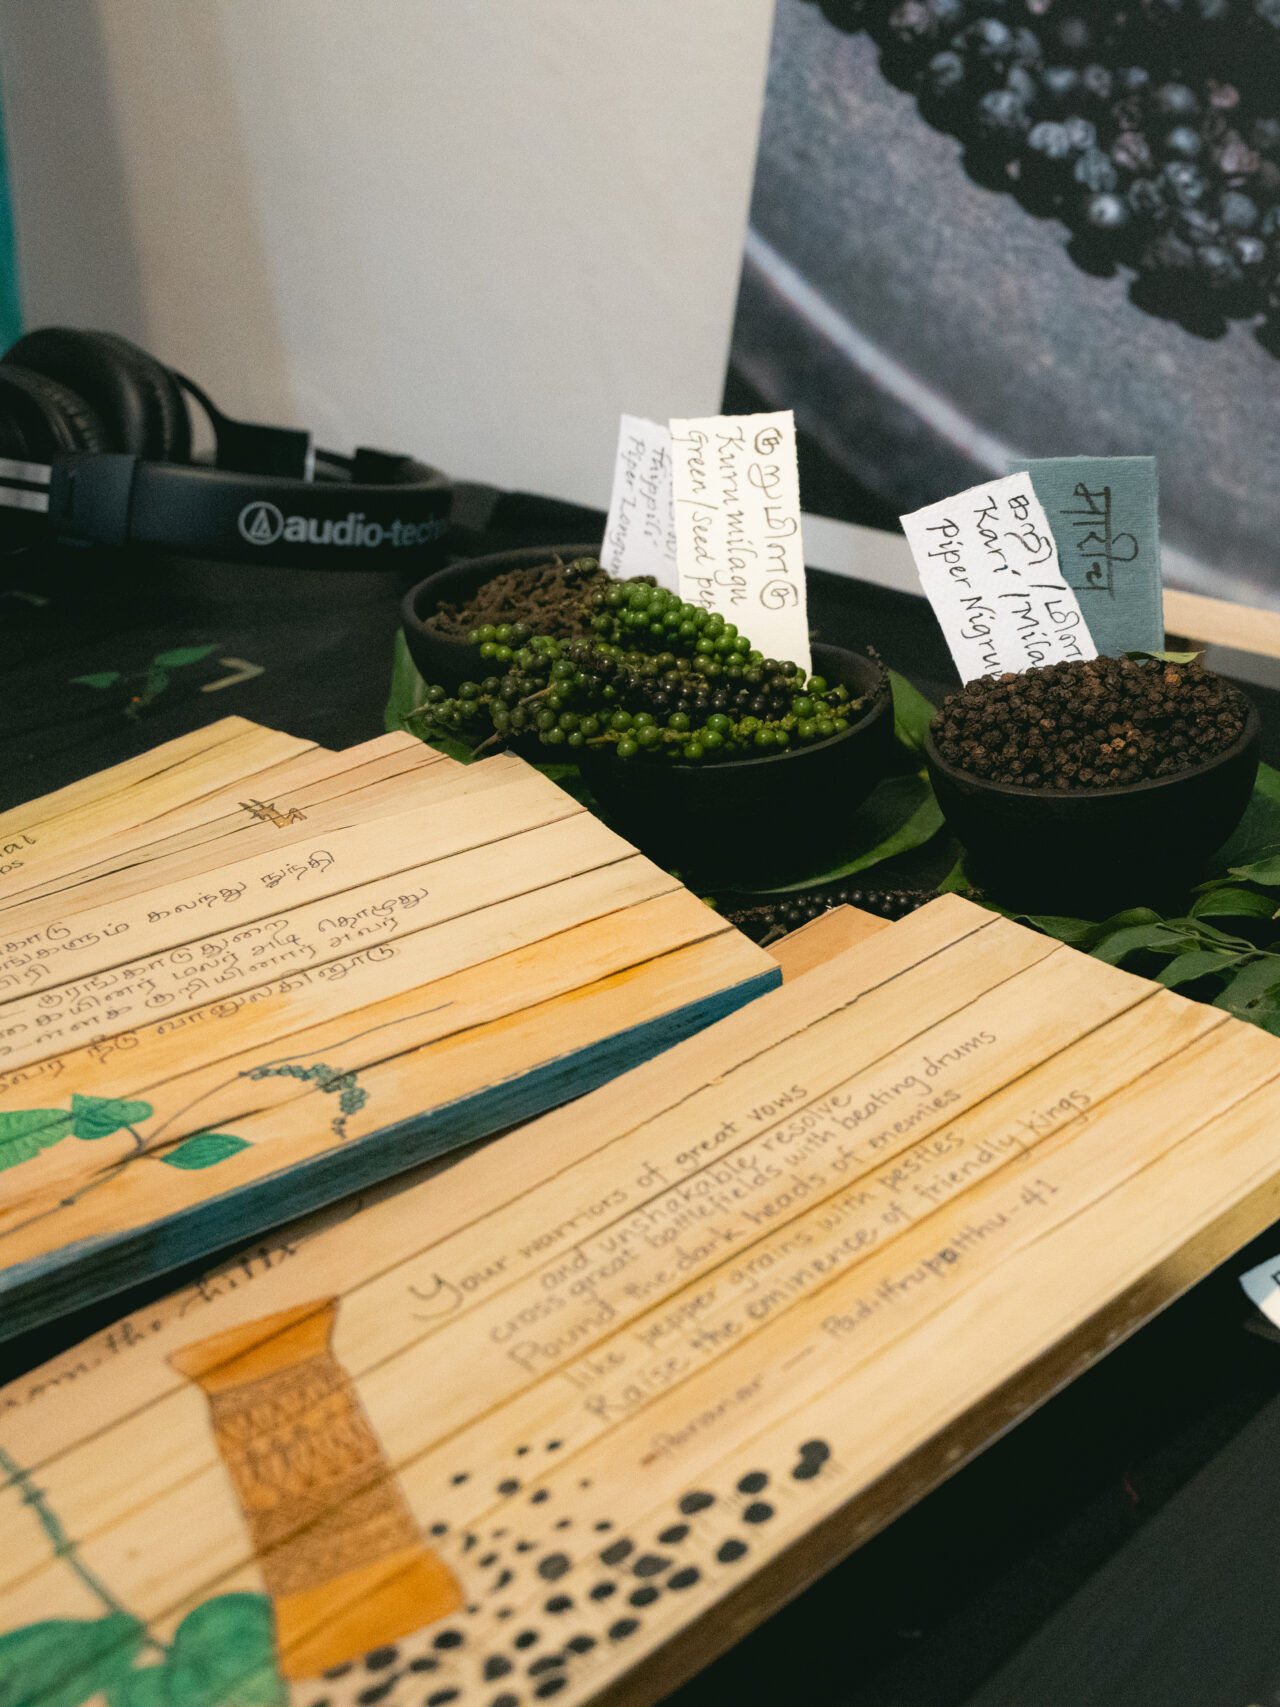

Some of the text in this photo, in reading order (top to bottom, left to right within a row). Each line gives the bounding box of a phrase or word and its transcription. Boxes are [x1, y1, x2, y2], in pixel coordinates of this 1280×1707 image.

[925, 518, 972, 589] Piper
[408, 1084, 807, 1322] Your warriors of great vows
[490, 1297, 565, 1343] cross
[569, 1250, 639, 1306] great
[784, 1122, 837, 1168] with
[833, 1074, 932, 1131] beating
[922, 1030, 997, 1077] drums
[541, 1093, 852, 1292] and unshakable resolve
[677, 1224, 745, 1272] dark
[742, 1172, 826, 1225] heads
[832, 1136, 863, 1172] of
[869, 1087, 960, 1149] enemies
[691, 1320, 743, 1352] the
[882, 1200, 915, 1225] of
[913, 1130, 1032, 1202] friendly
[1016, 1088, 1092, 1138] kings
[730, 1233, 813, 1292] grains
[817, 1188, 875, 1232] with
[878, 1131, 966, 1192] pestles
